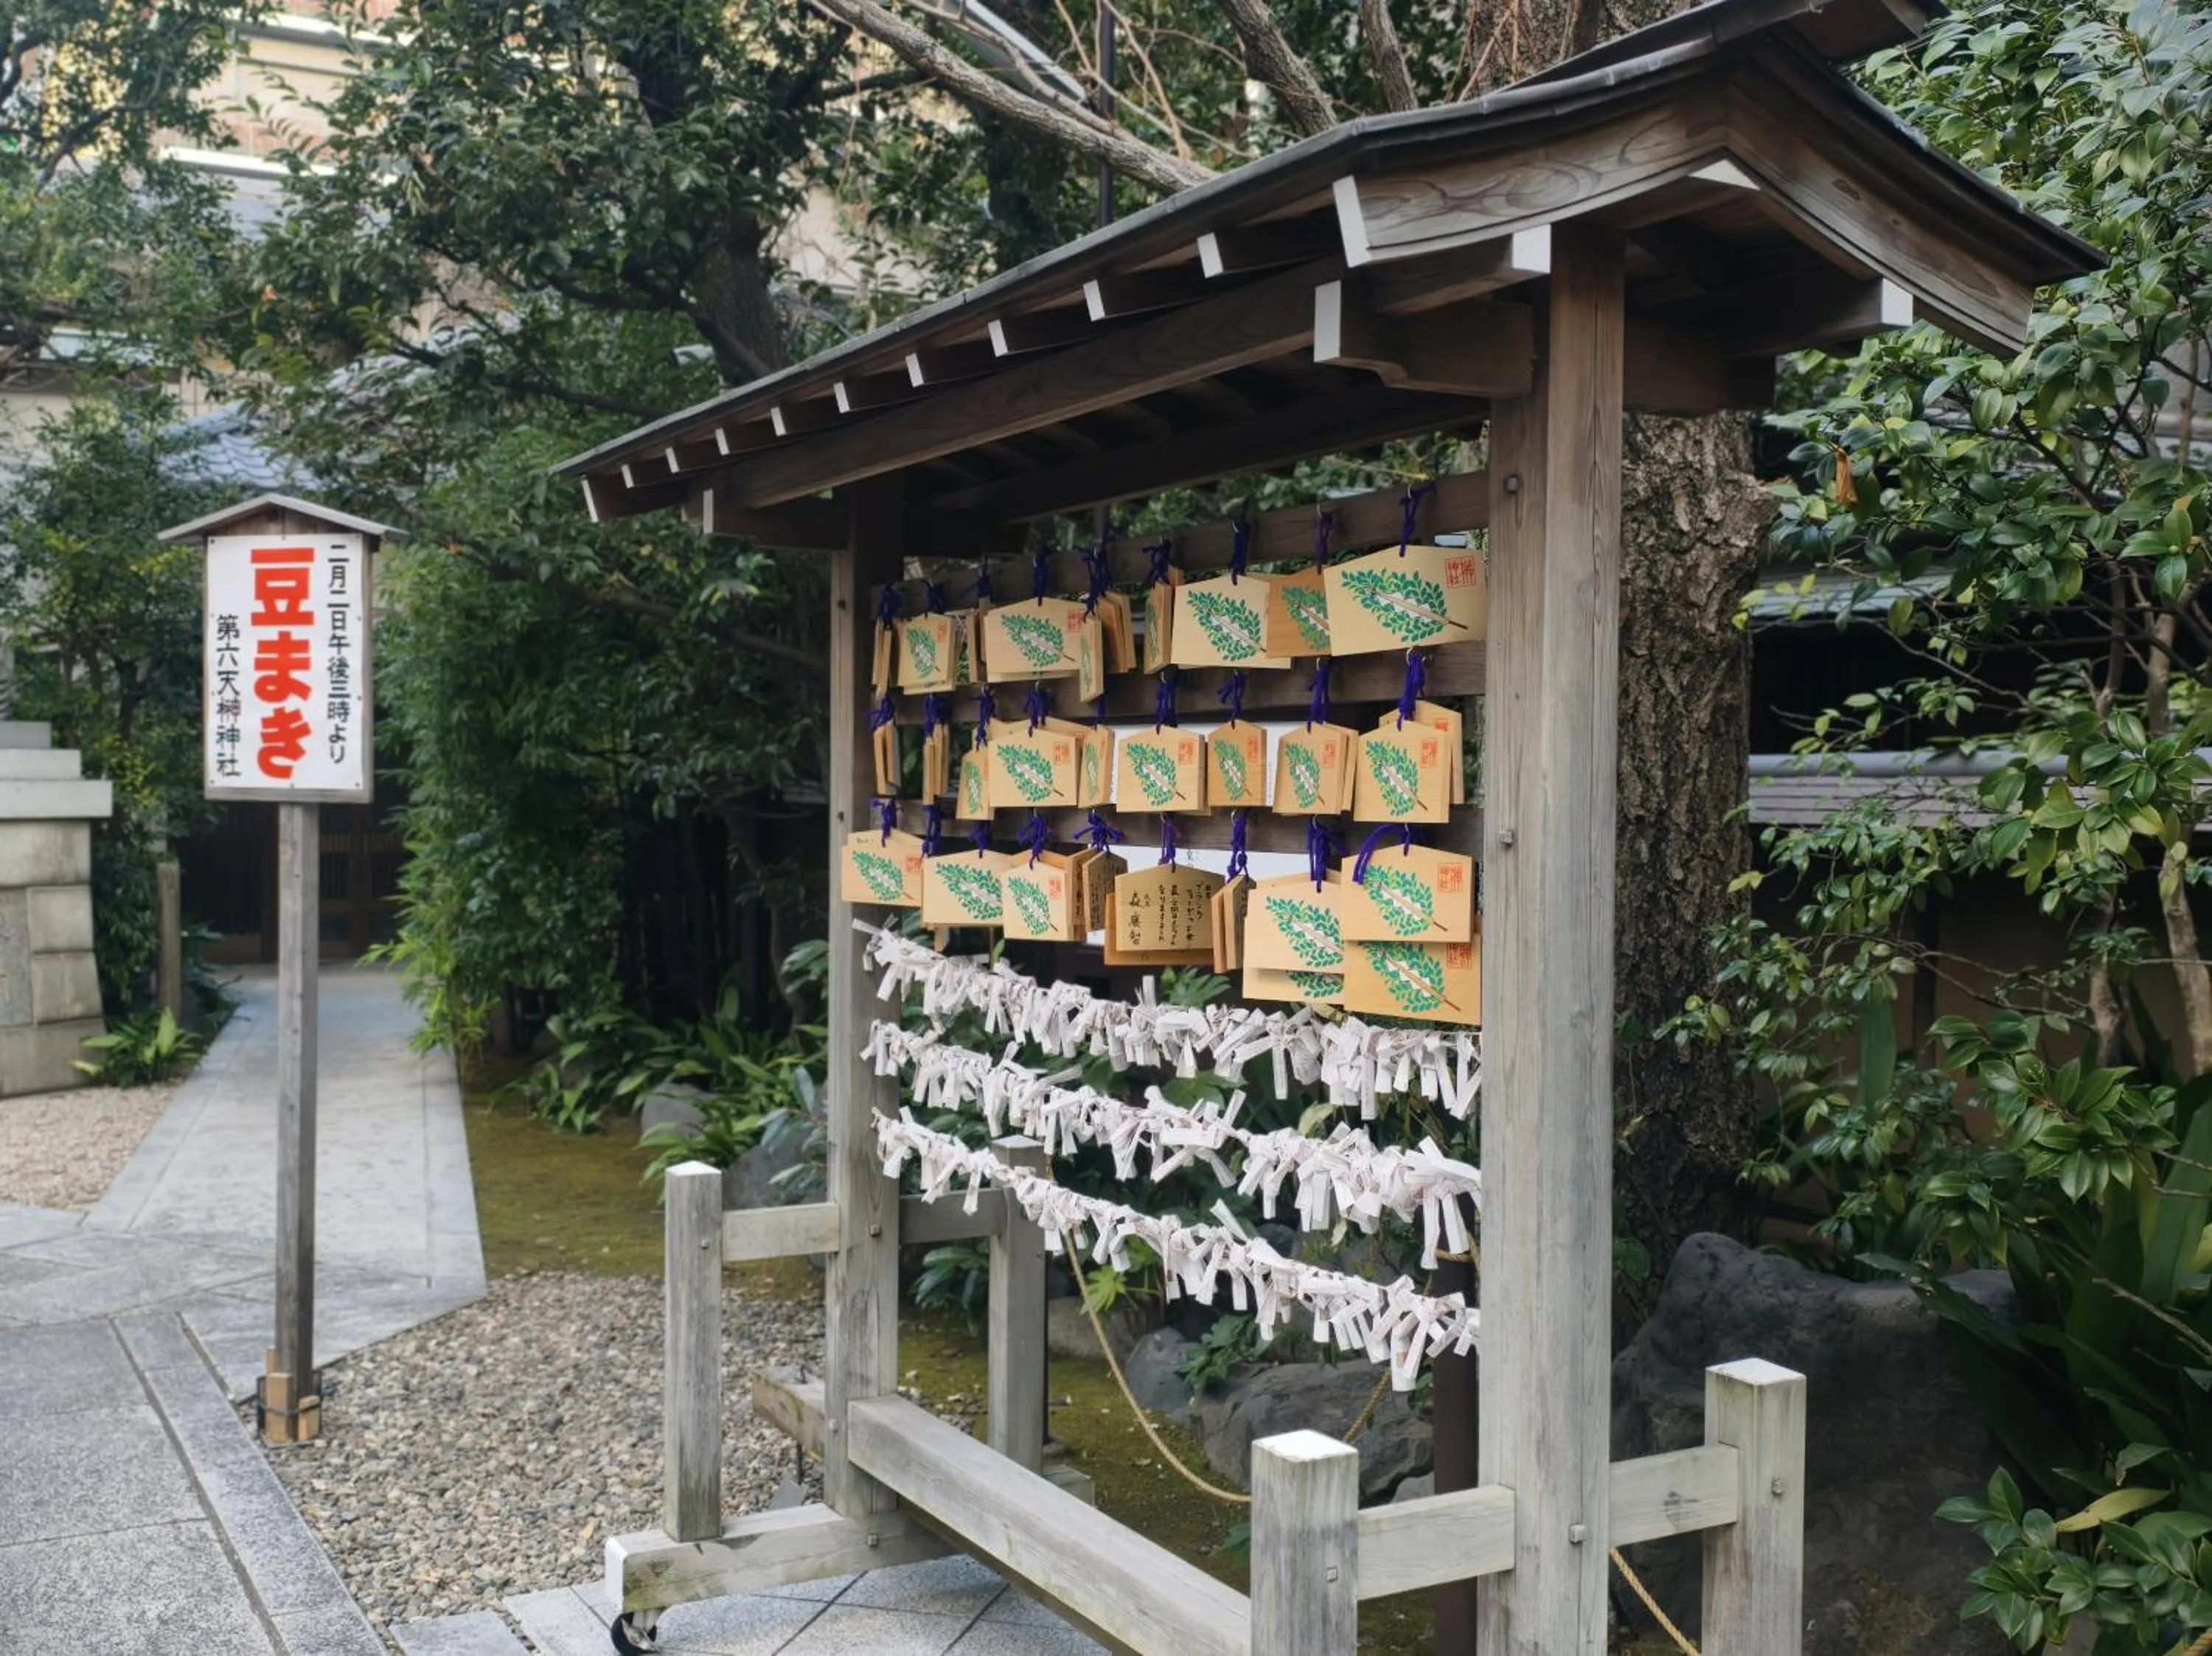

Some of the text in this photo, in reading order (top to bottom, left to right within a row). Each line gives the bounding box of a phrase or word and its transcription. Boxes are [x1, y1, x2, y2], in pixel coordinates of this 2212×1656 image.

[217, 614, 241, 776] 第六天榊神社
[251, 548, 314, 779] 豆まき
[327, 544, 350, 763] 二月二日午後三時より
